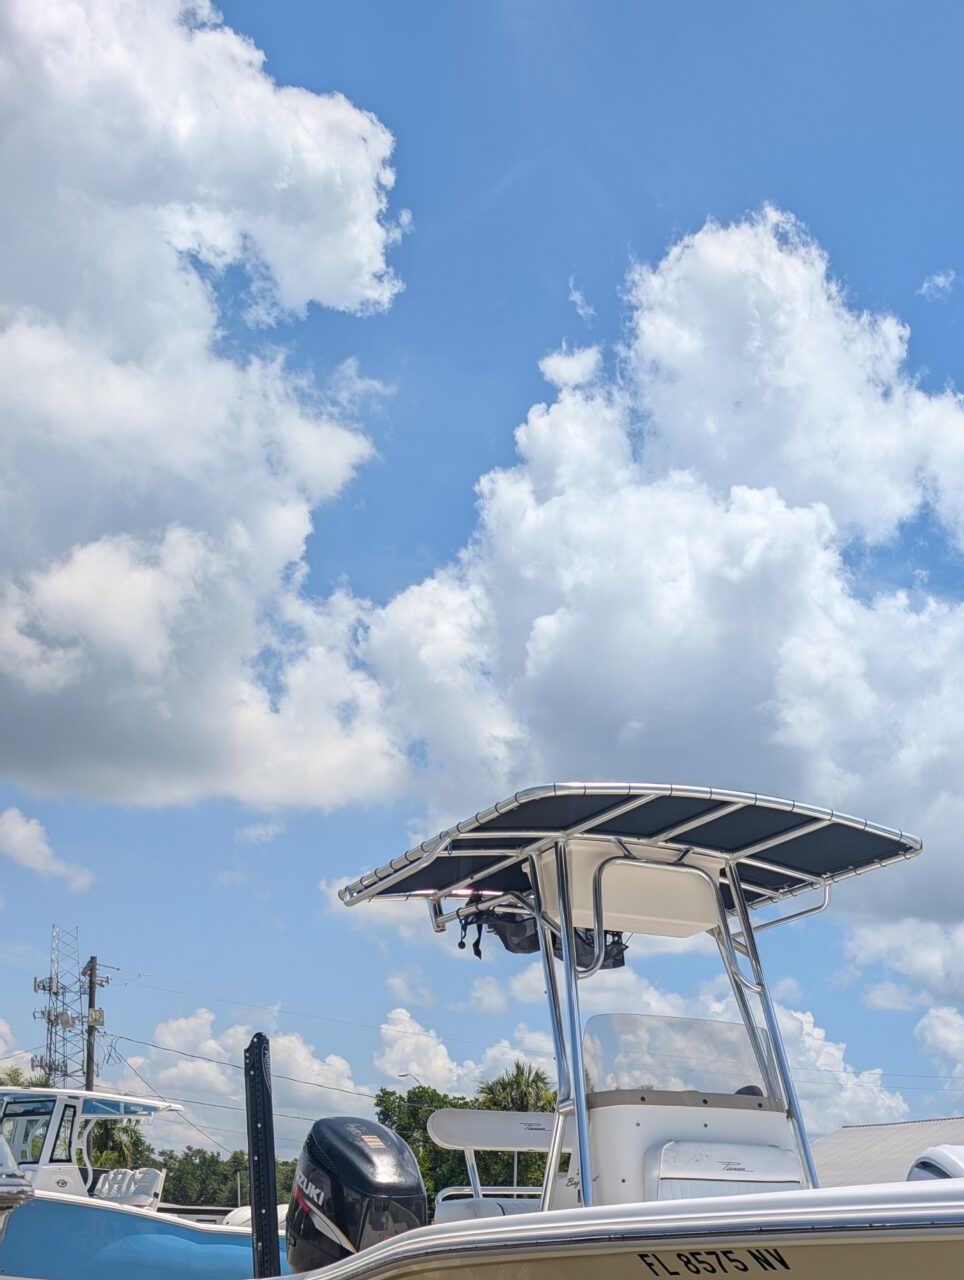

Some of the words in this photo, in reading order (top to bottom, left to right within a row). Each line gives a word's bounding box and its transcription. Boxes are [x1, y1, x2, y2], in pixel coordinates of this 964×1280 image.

[637, 1253, 681, 1277] FL
[676, 1250, 749, 1275] 8575
[747, 1248, 791, 1272] NV
